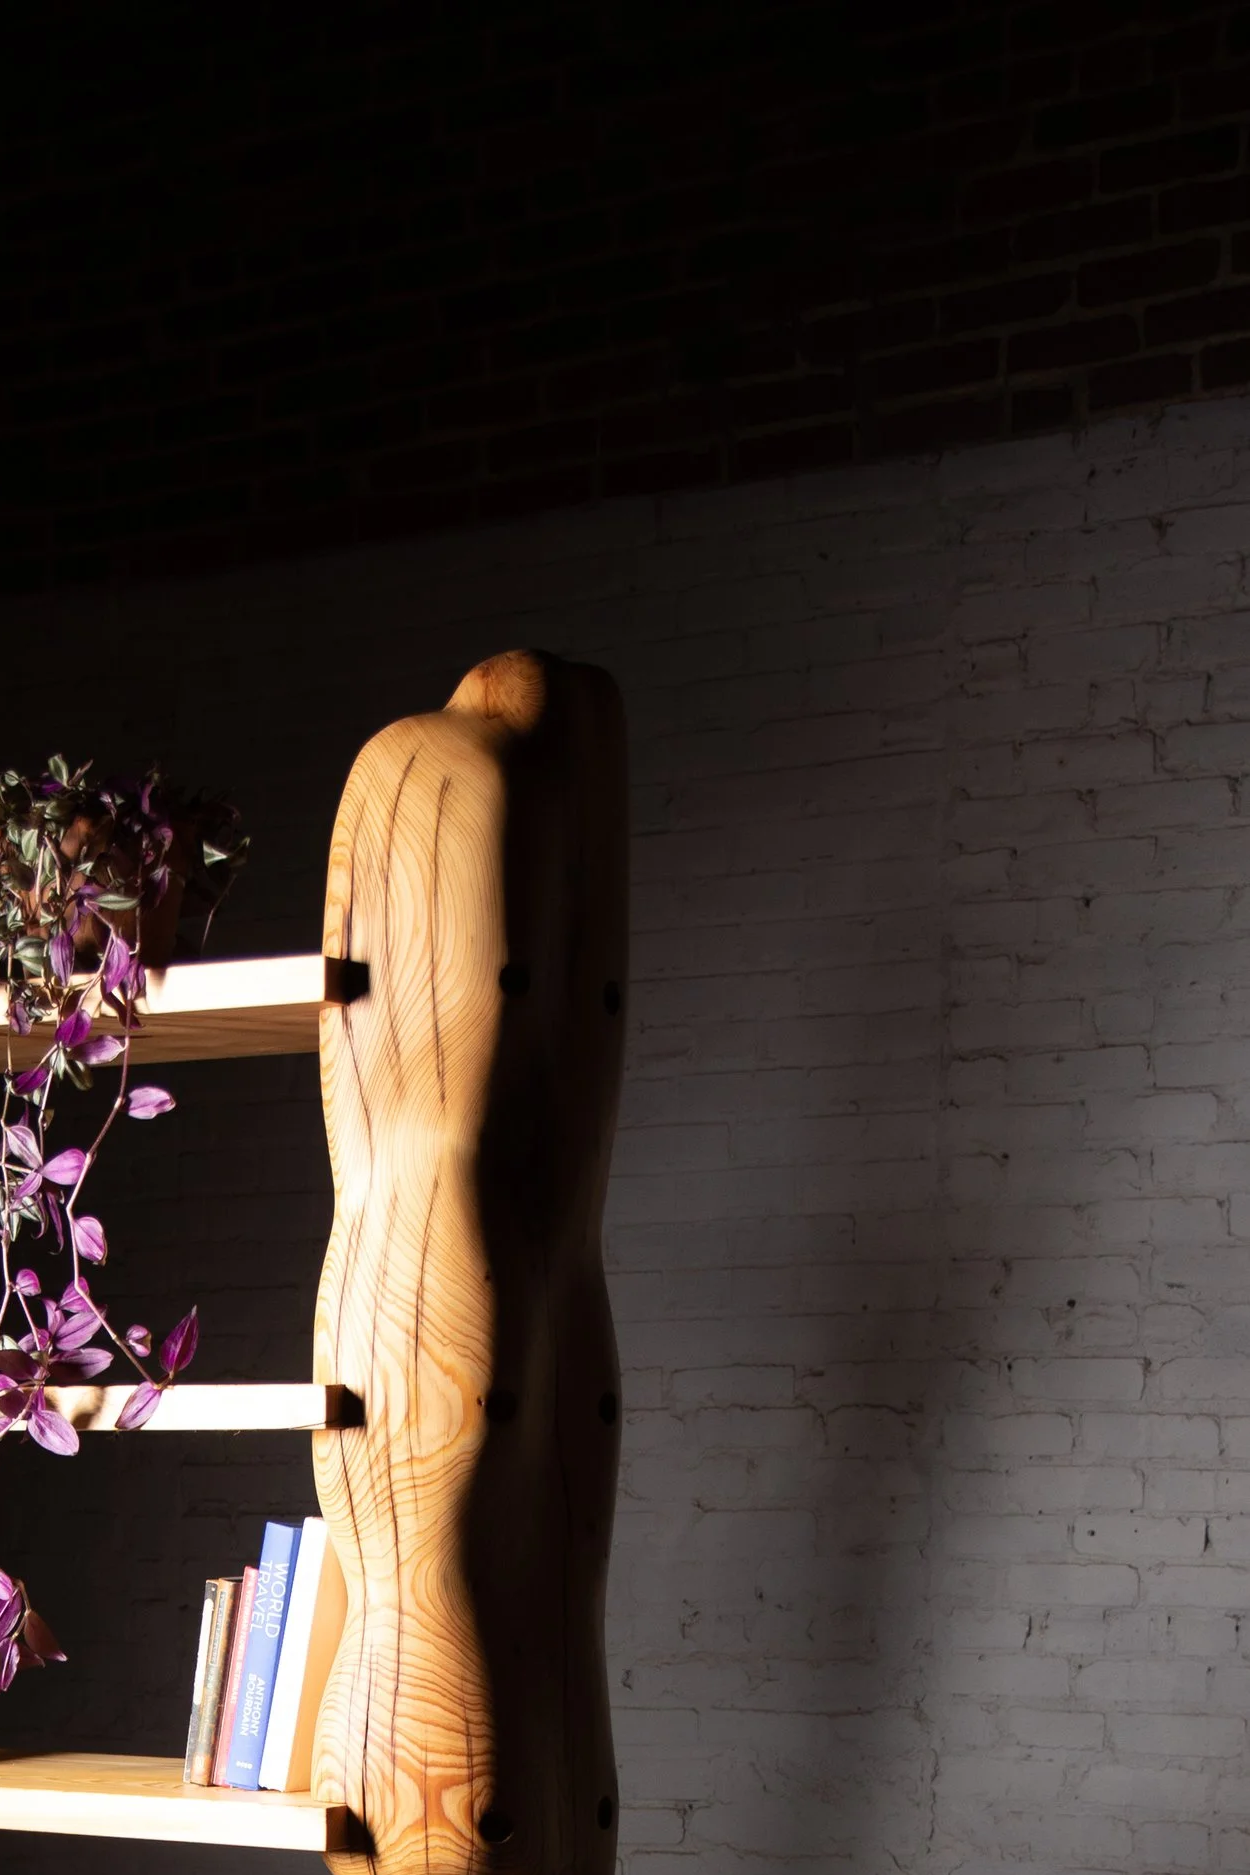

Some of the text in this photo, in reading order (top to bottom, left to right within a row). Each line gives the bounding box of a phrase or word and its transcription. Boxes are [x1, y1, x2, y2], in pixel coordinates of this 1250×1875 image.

[251, 1560, 273, 1633] TRAVEL
[265, 1563, 289, 1638] WORLD
[239, 1673, 256, 1736] BOURDAIN
[250, 1677, 265, 1737] ANTHONY
